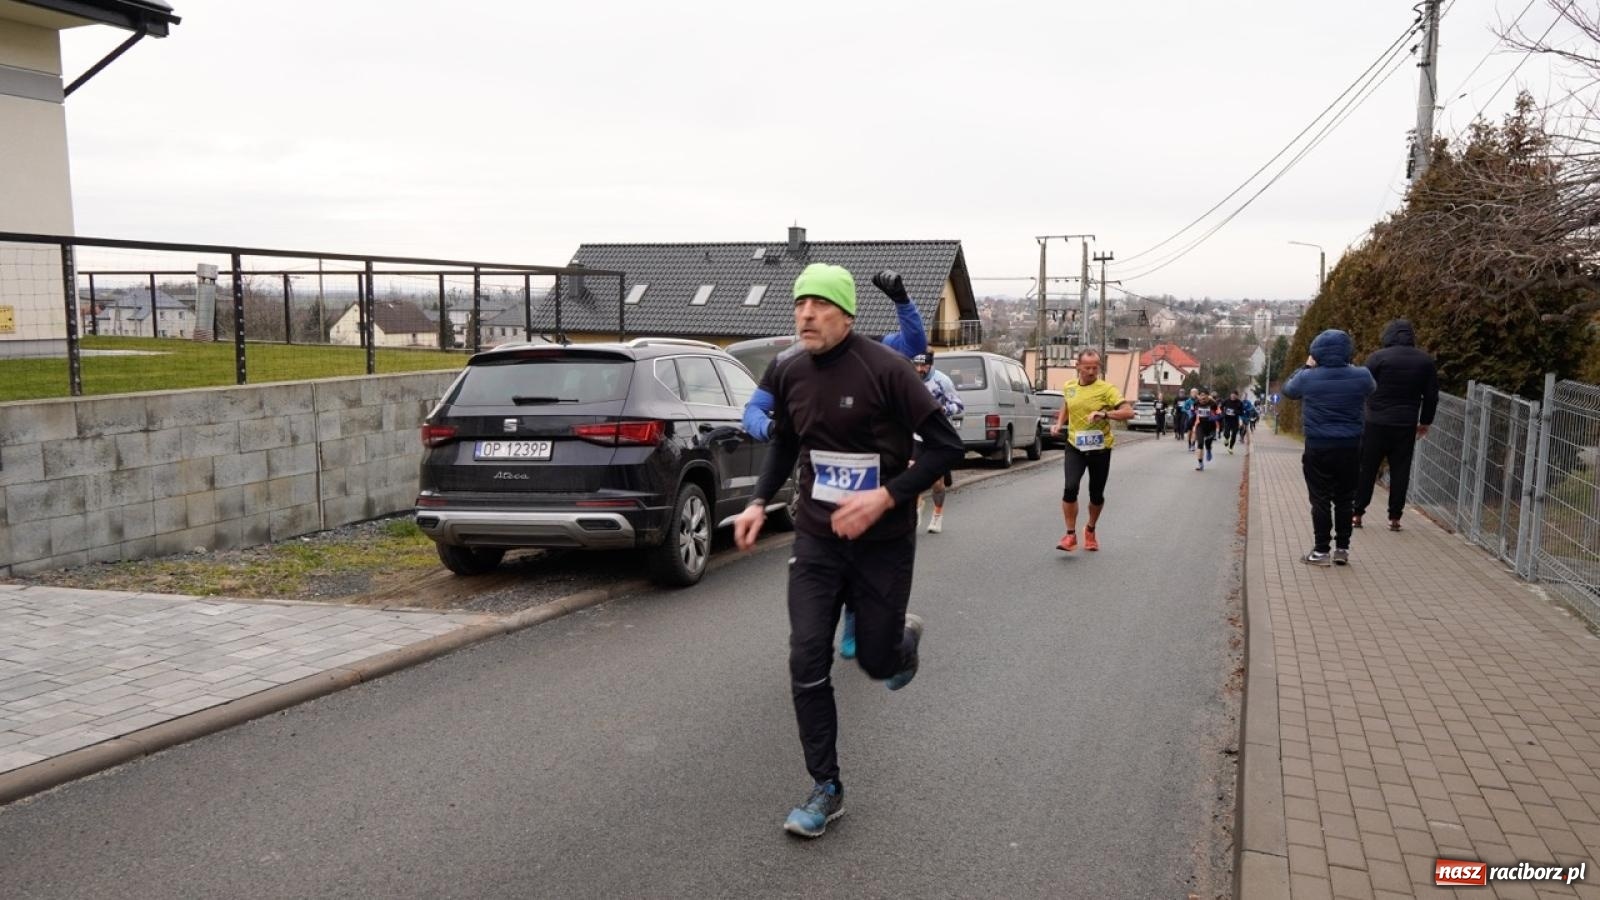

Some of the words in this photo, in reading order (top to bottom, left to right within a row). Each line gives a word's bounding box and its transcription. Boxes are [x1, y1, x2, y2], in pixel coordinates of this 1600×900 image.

[1079, 434, 1101, 445] 186
[484, 442, 501, 456] OP
[507, 442, 548, 456] 1239P
[825, 465, 868, 491] 187
